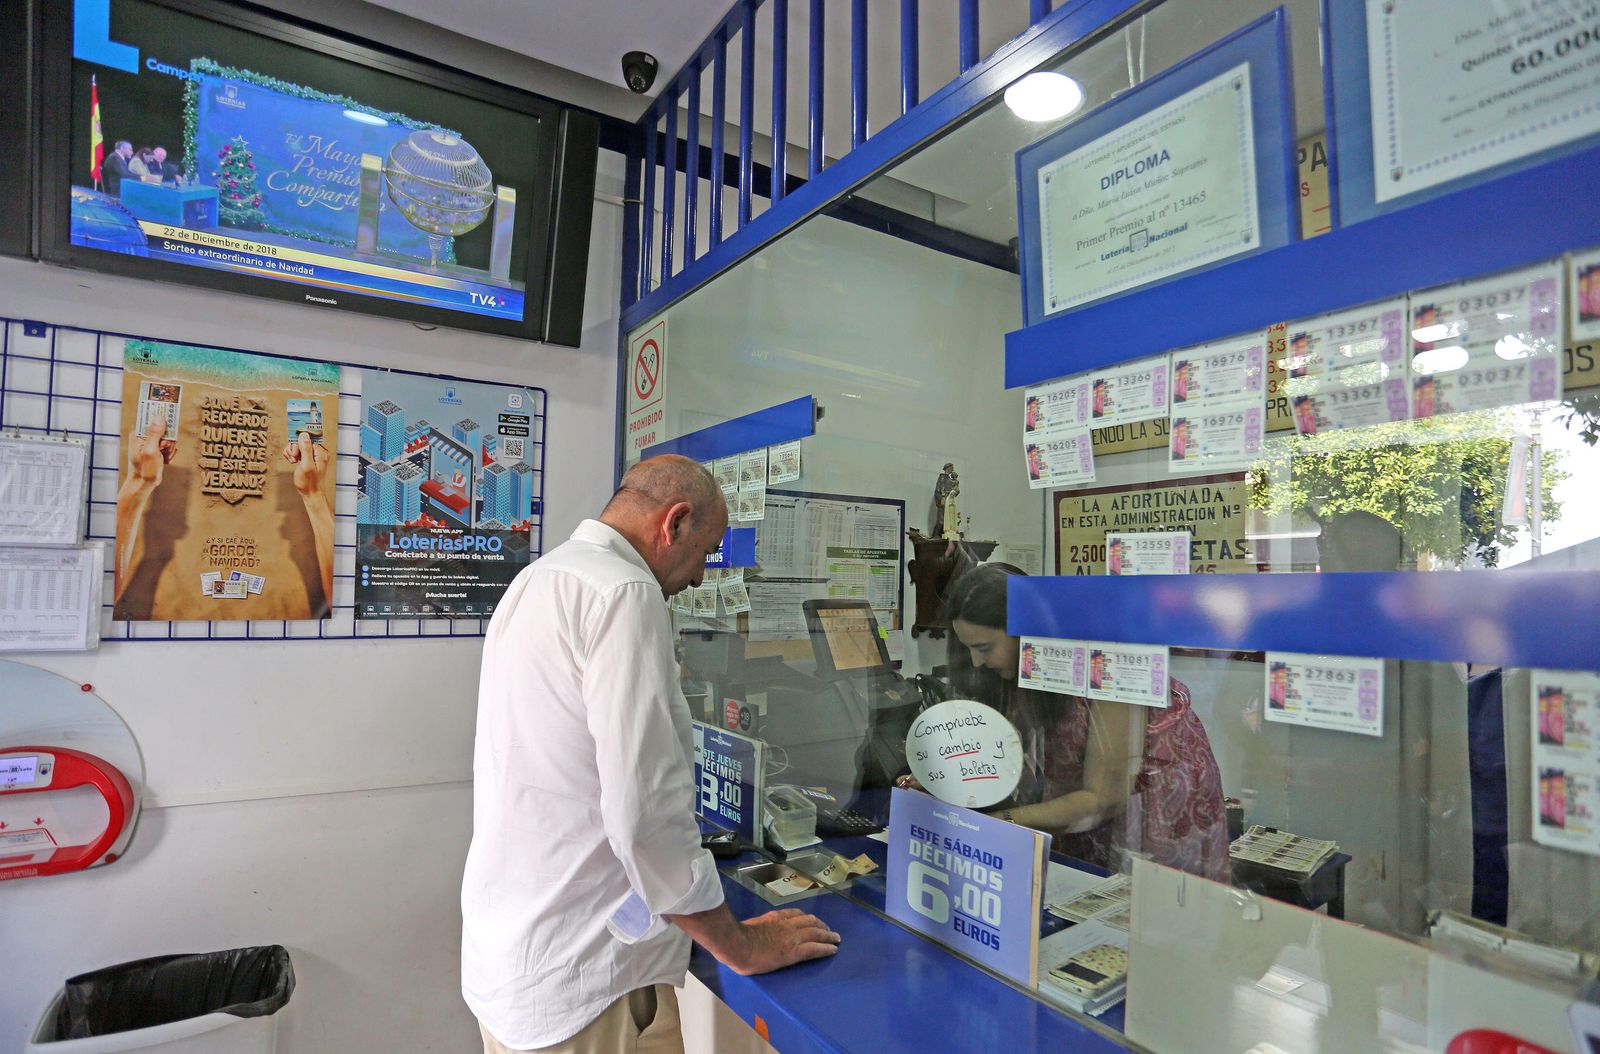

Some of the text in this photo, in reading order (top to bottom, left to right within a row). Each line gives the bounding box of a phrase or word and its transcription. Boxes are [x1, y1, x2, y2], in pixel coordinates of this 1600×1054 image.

[1100, 149, 1171, 191] DIPLOMA
[1076, 233, 1107, 251] Primer
[1109, 218, 1144, 239] Premio
[1146, 210, 1156, 224] al
[1173, 192, 1207, 213] 13465
[163, 228, 277, 256] 22 de Diciembre de 2018
[1149, 222, 1188, 244] Nacional
[163, 241, 314, 276] Sorteo extraordinario de Navidad
[305, 294, 338, 305] Panasonic
[469, 292, 497, 307] TV4
[1458, 287, 1526, 314] 03037
[1327, 319, 1378, 338] 13367
[1204, 354, 1245, 368] 16976
[1118, 373, 1151, 387] 13366
[1458, 365, 1526, 386] 03037
[1047, 389, 1076, 403] 16205
[1330, 386, 1381, 402] 13367
[201, 410, 269, 429] RECUERDO
[629, 409, 663, 435] PROHIBIDO
[1203, 415, 1244, 427] 16976
[201, 426, 268, 447] QUIERES
[1130, 421, 1147, 440] LA
[635, 432, 656, 449] FUMAR
[1047, 440, 1077, 451] 16205
[201, 443, 267, 462] LLEVARTE
[221, 459, 247, 471] ESTE
[201, 471, 267, 490] VERANO?
[1062, 504, 1241, 528] EN ESTA ADMINISTRACION Nº
[210, 544, 255, 557] GORDO
[389, 532, 502, 552] LoteríasPRO
[1136, 540, 1171, 550] 12559
[210, 557, 261, 568] NAVIDAD?
[385, 551, 428, 559] Conéctate
[447, 553, 470, 561] punto
[705, 553, 723, 563] UROS
[1042, 647, 1073, 658] 07680
[1115, 654, 1150, 665] 11081
[1305, 668, 1355, 684] 27863
[915, 711, 986, 739] Compruebe
[704, 749, 715, 761] STE
[717, 754, 742, 771] JUEVES
[916, 740, 1005, 761] su cambio y
[928, 770, 945, 781] sus
[720, 804, 741, 824] EUROS
[911, 824, 1003, 870] ESTE SÁBADO
[909, 839, 1003, 892] DÉCIMOS
[907, 860, 1001, 927] 6,00
[953, 915, 1000, 952] EUROS
